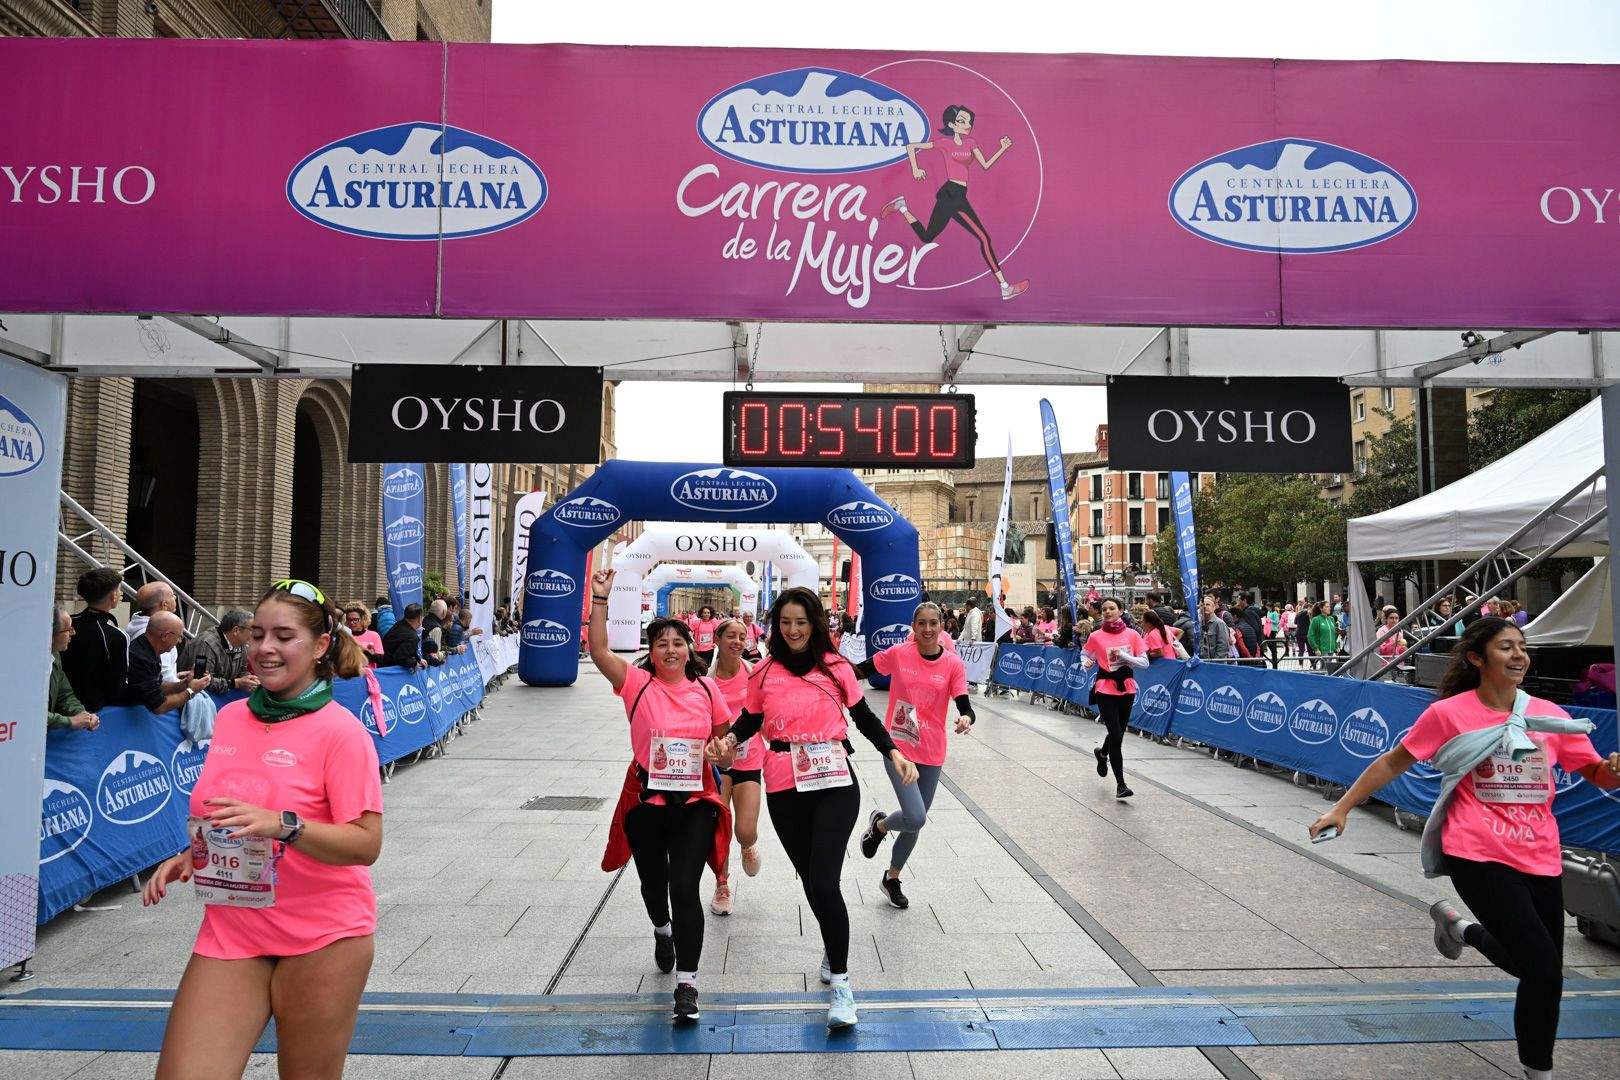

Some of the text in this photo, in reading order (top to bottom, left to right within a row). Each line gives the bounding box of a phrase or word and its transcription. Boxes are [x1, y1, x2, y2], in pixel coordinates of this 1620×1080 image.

[751, 102, 905, 117] CENTRAL LECHERA
[715, 104, 911, 147] ASTURIANA
[348, 163, 519, 175] CENTRAL LECHERA
[306, 164, 527, 210] ASTURIANA
[676, 164, 868, 222] Carrera
[1226, 177, 1390, 190] CENTRAL LECHERA
[1188, 180, 1400, 224] ASTURIANA
[1540, 186, 1620, 225] OY
[722, 218, 939, 309] de la Mujer
[391, 396, 566, 433] OYSHO
[1147, 409, 1316, 444] OYSHO
[679, 480, 769, 501] ASTURIANA
[557, 506, 615, 521] ASTURIANA
[833, 513, 890, 524] ASTURIANA
[675, 535, 757, 552] OYSHO
[528, 579, 572, 592] ASTURIANA
[873, 585, 918, 595] ASTURIANA
[521, 629, 566, 642] ASTURIANA
[1207, 696, 1240, 717] ASTURIANA
[1247, 704, 1282, 725] ASTURIANA
[1291, 712, 1333, 736] ASTURIANA
[1341, 721, 1384, 750] ASTURIANA
[668, 758, 687, 767] 016
[812, 756, 831, 766] 016
[1496, 764, 1523, 774] 016
[112, 766, 162, 788] CENTRAL LECHERA
[47, 795, 80, 810] LECHERA
[105, 774, 170, 815] ASTURIANA
[211, 853, 240, 869] 016
[215, 869, 233, 880] 4111
